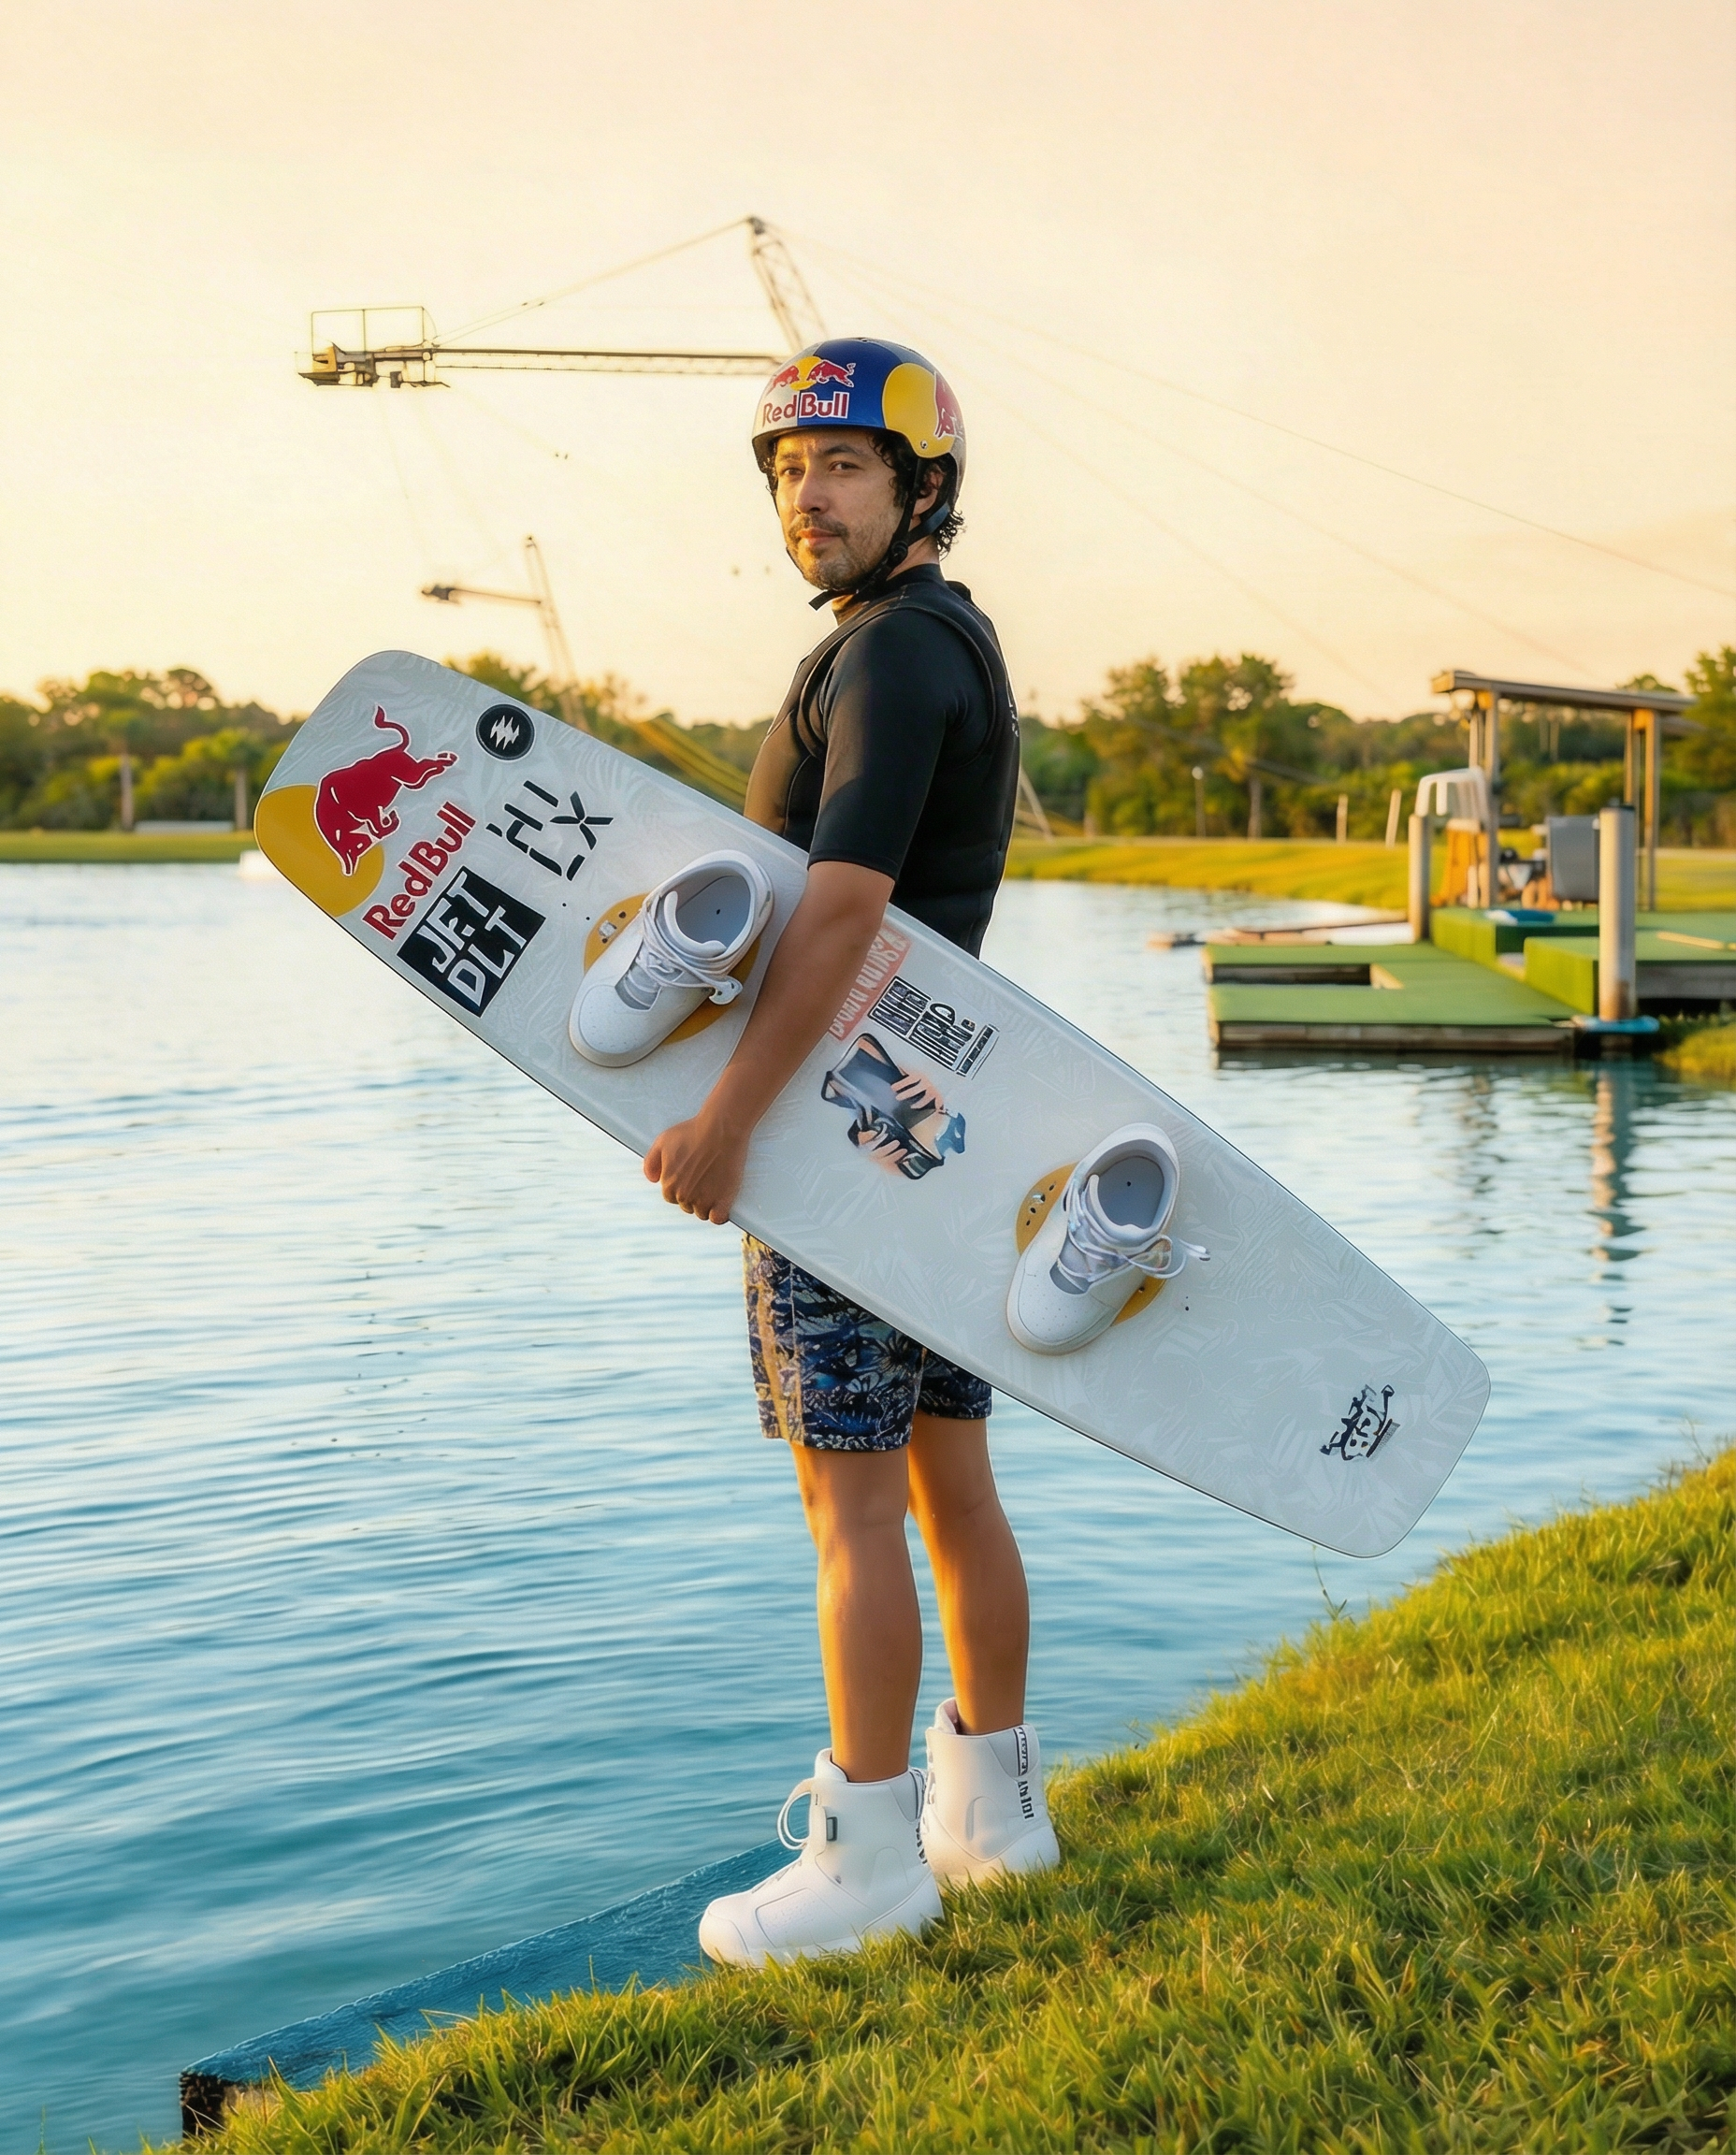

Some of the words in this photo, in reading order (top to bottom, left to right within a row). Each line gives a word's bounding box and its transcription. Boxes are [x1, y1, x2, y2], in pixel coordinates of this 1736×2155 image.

[762, 394, 798, 427] Red
[799, 391, 849, 419] Bull
[362, 860, 434, 941] Red
[408, 801, 477, 878] Bull
[447, 904, 528, 1007] DLT
